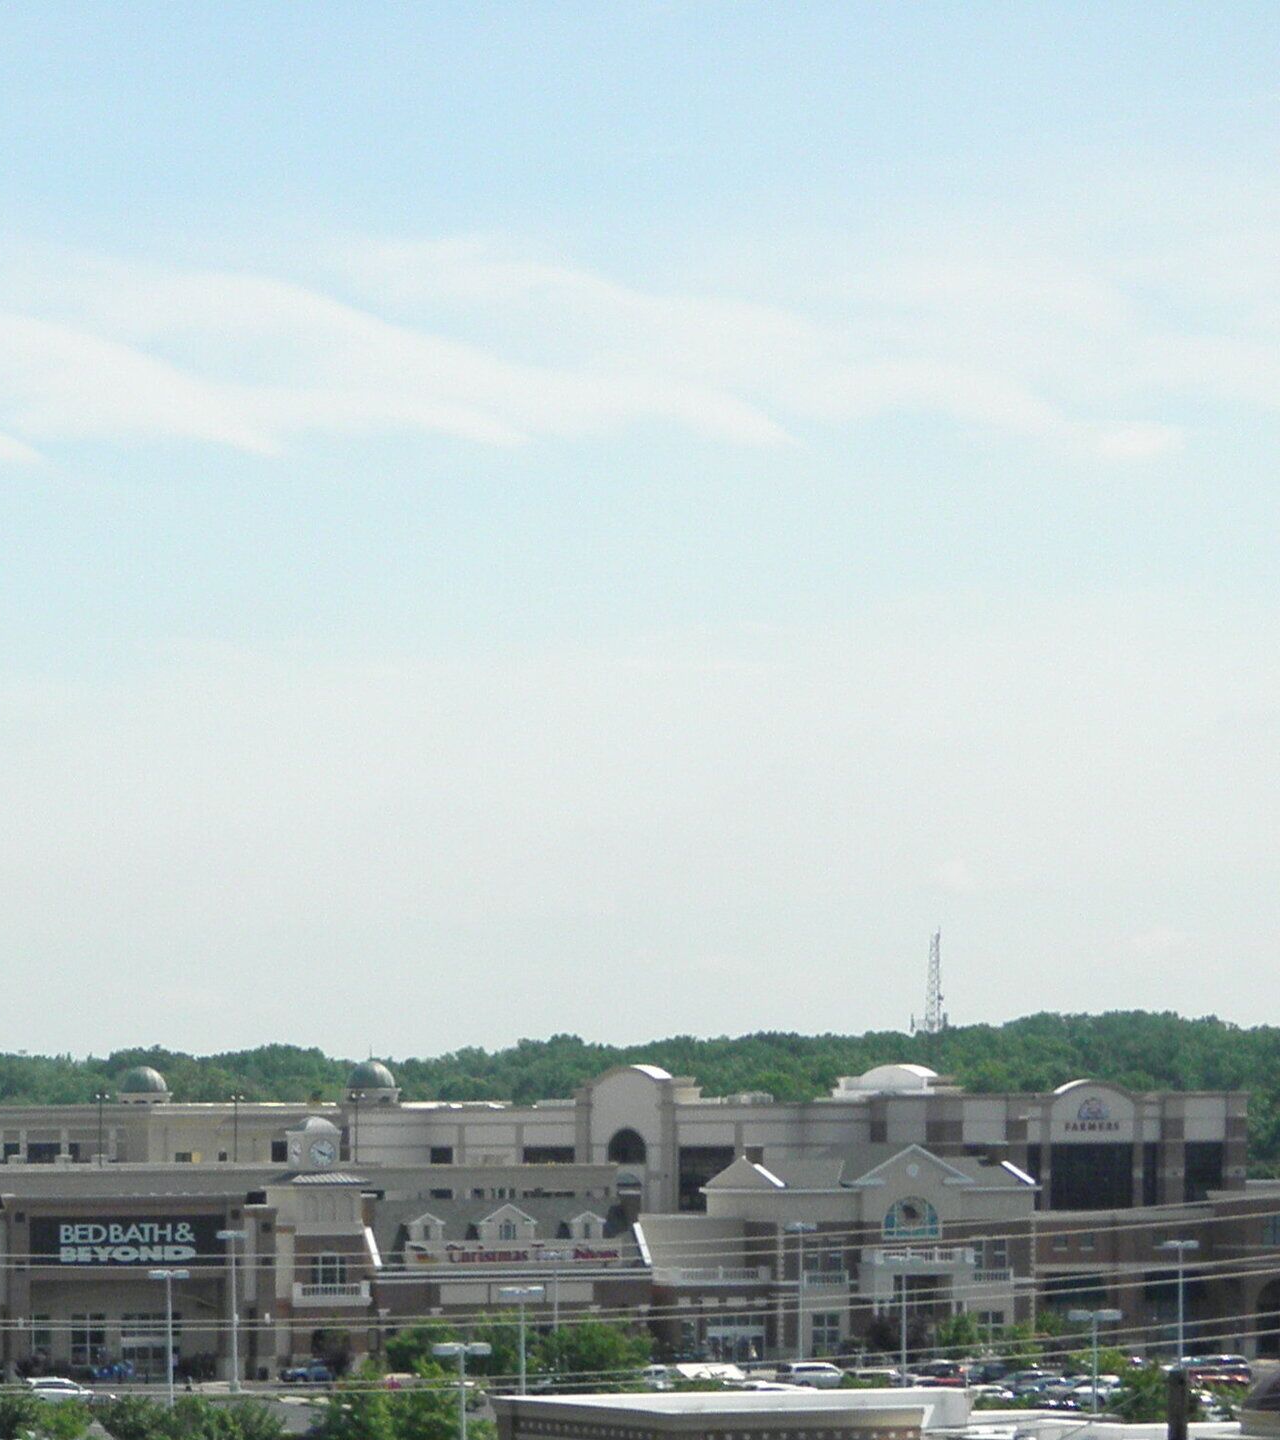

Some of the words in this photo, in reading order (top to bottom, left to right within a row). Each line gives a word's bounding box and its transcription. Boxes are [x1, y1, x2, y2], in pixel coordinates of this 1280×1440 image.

[60, 1224, 107, 1243] BED
[109, 1223, 172, 1243] BATH
[175, 1222, 195, 1242] &
[60, 1245, 197, 1262] BEYOND
